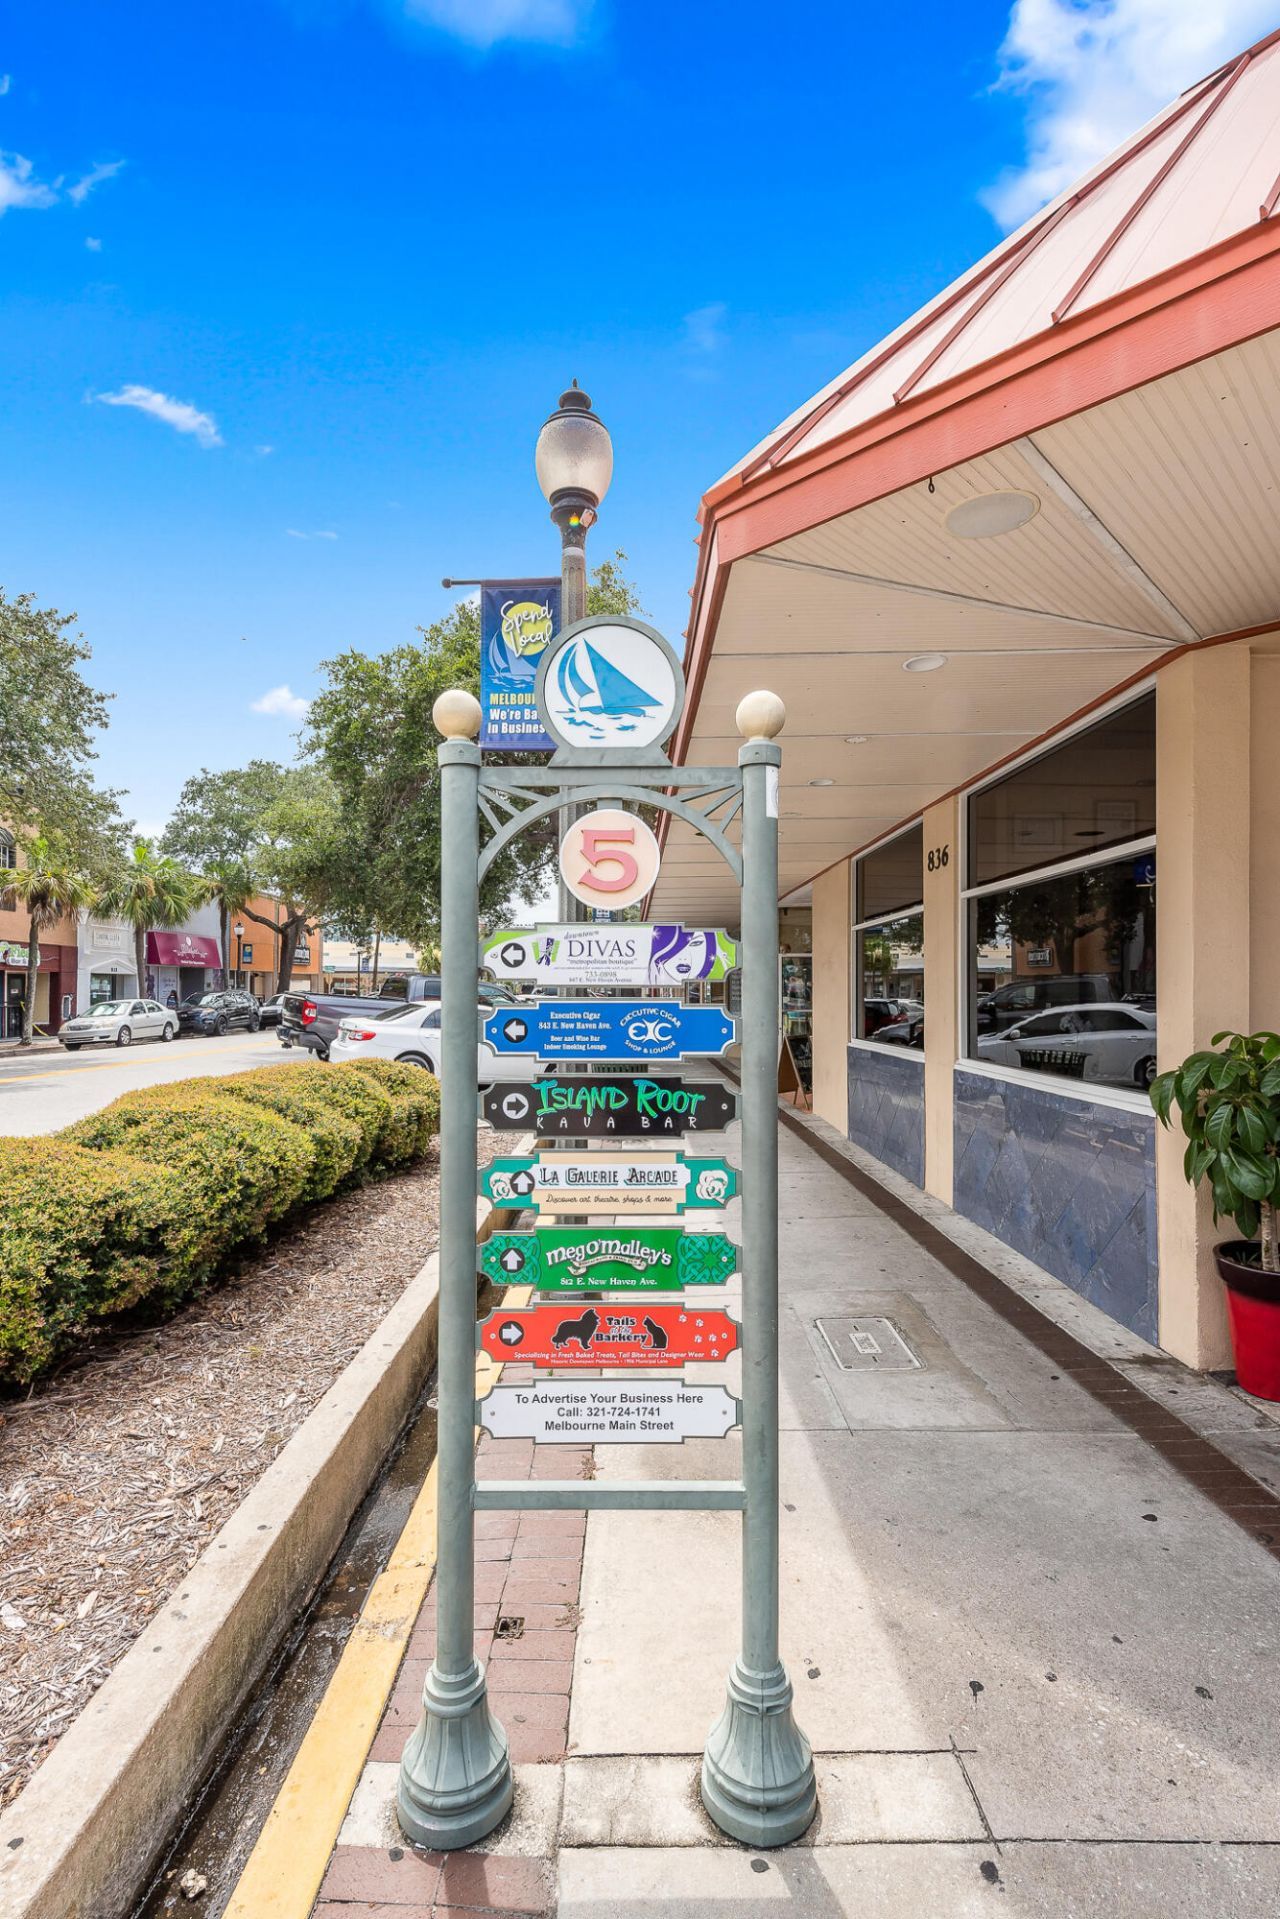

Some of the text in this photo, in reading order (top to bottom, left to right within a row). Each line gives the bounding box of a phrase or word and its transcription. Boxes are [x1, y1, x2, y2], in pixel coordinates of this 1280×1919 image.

[501, 600, 553, 632] Spend
[510, 623, 553, 658] Local
[489, 708, 538, 720] We're Ba
[501, 722, 546, 734] Busines
[577, 828, 638, 893] 5
[927, 844, 950, 872] 836
[564, 931, 600, 940] downtown
[568, 939, 636, 958] DIVAS
[583, 1012, 601, 1020] Cigar
[619, 1008, 682, 1029] EXECUTIVE CIGAR
[538, 1022, 551, 1030] 843
[598, 1022, 612, 1030] Ave.
[562, 1043, 586, 1051] Smoking
[586, 1043, 607, 1051] Lounge
[624, 1040, 642, 1052] SHOP
[649, 1040, 677, 1054] LOUNGE
[641, 1117, 697, 1129] BAR
[546, 1194, 577, 1203] Discover
[623, 1195, 643, 1205] shops
[560, 1277, 658, 1286] 812 E. New Haven Ave.
[605, 1316, 637, 1327] Tails
[595, 1332, 648, 1344] Barkery
[514, 1352, 549, 1360] Specializing
[660, 1352, 687, 1360] Designer
[515, 1393, 704, 1404] To Advertise Your Business Here
[557, 1407, 661, 1417] Call: 321-724-1741
[545, 1420, 674, 1431] Melbourne Main Street
